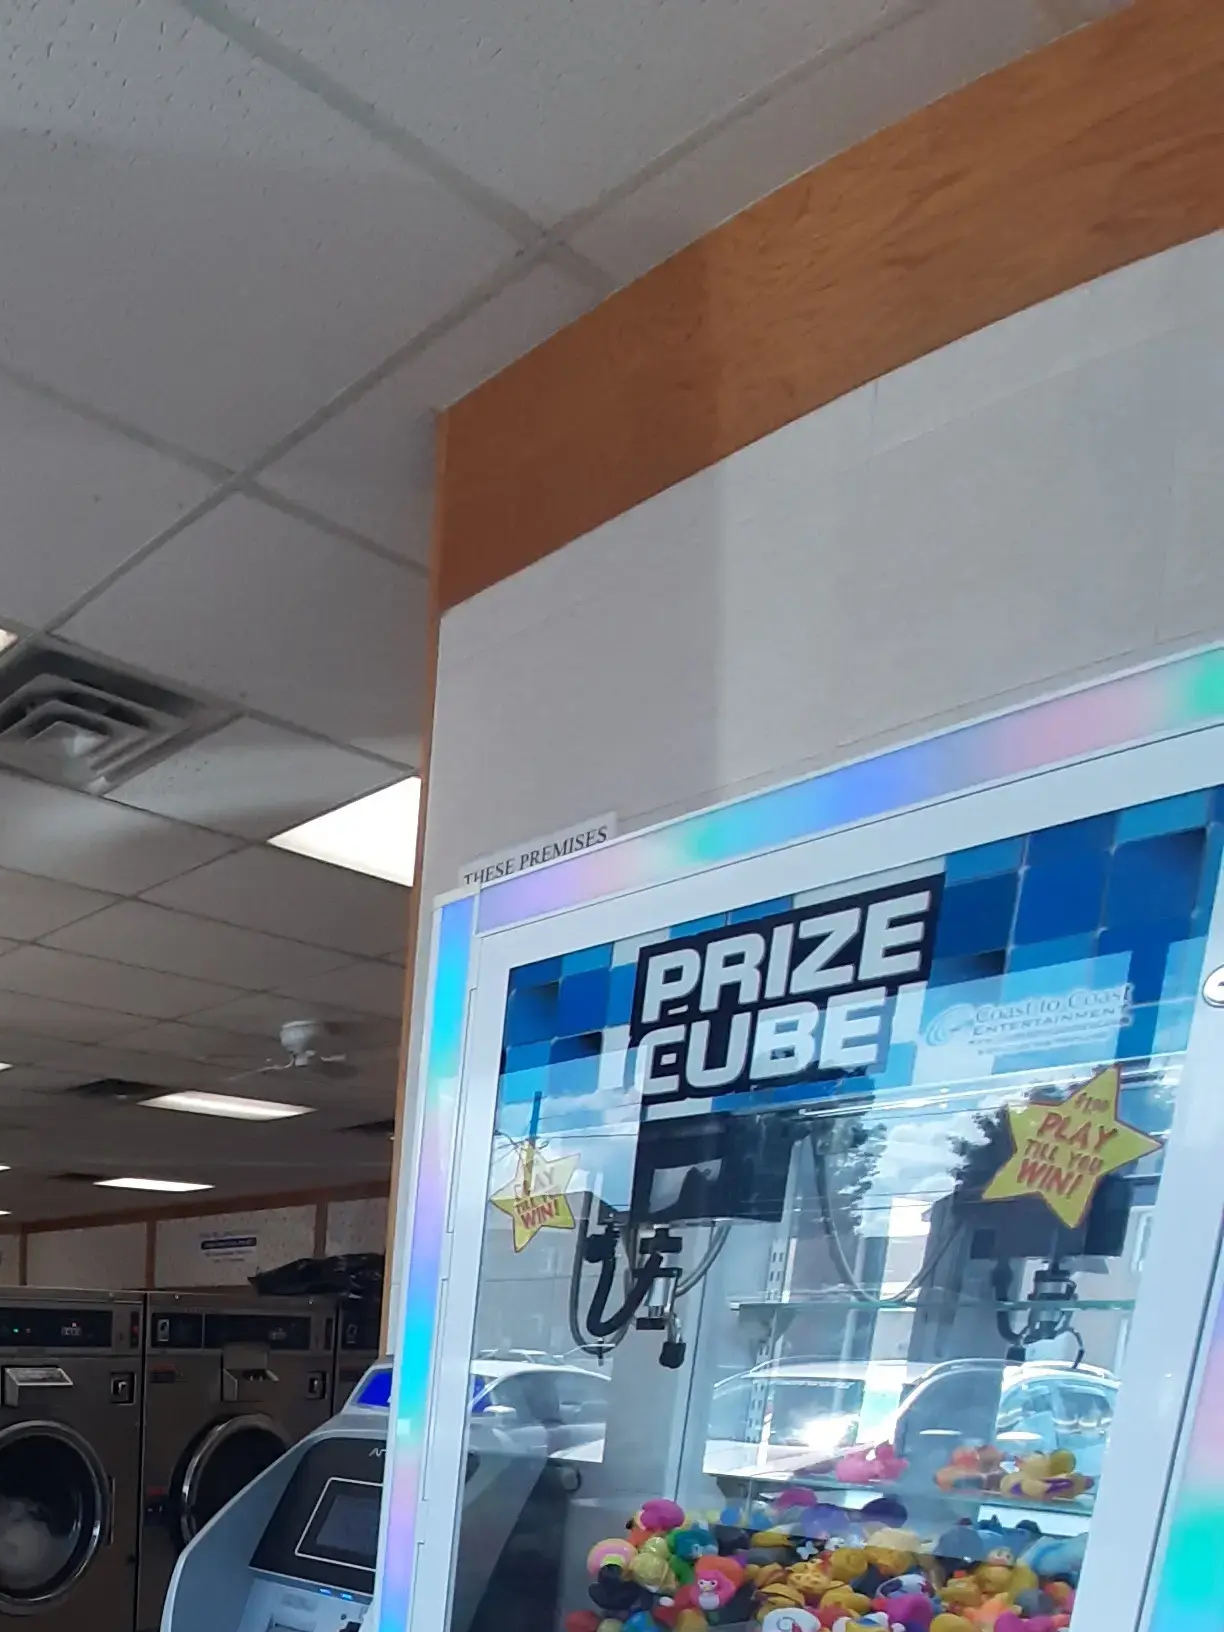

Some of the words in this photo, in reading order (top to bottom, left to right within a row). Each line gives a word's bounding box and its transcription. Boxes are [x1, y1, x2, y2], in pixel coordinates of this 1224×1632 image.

[463, 857, 516, 885] THESE
[518, 825, 608, 871] PREMISES
[640, 890, 932, 1025] PRIZE
[635, 986, 887, 1096] CUBE
[1037, 1112, 1118, 1150] PLAY
[1016, 1158, 1083, 1199] WIN!
[1024, 1138, 1058, 1161] TILL
[1067, 1150, 1104, 1175] YOU
